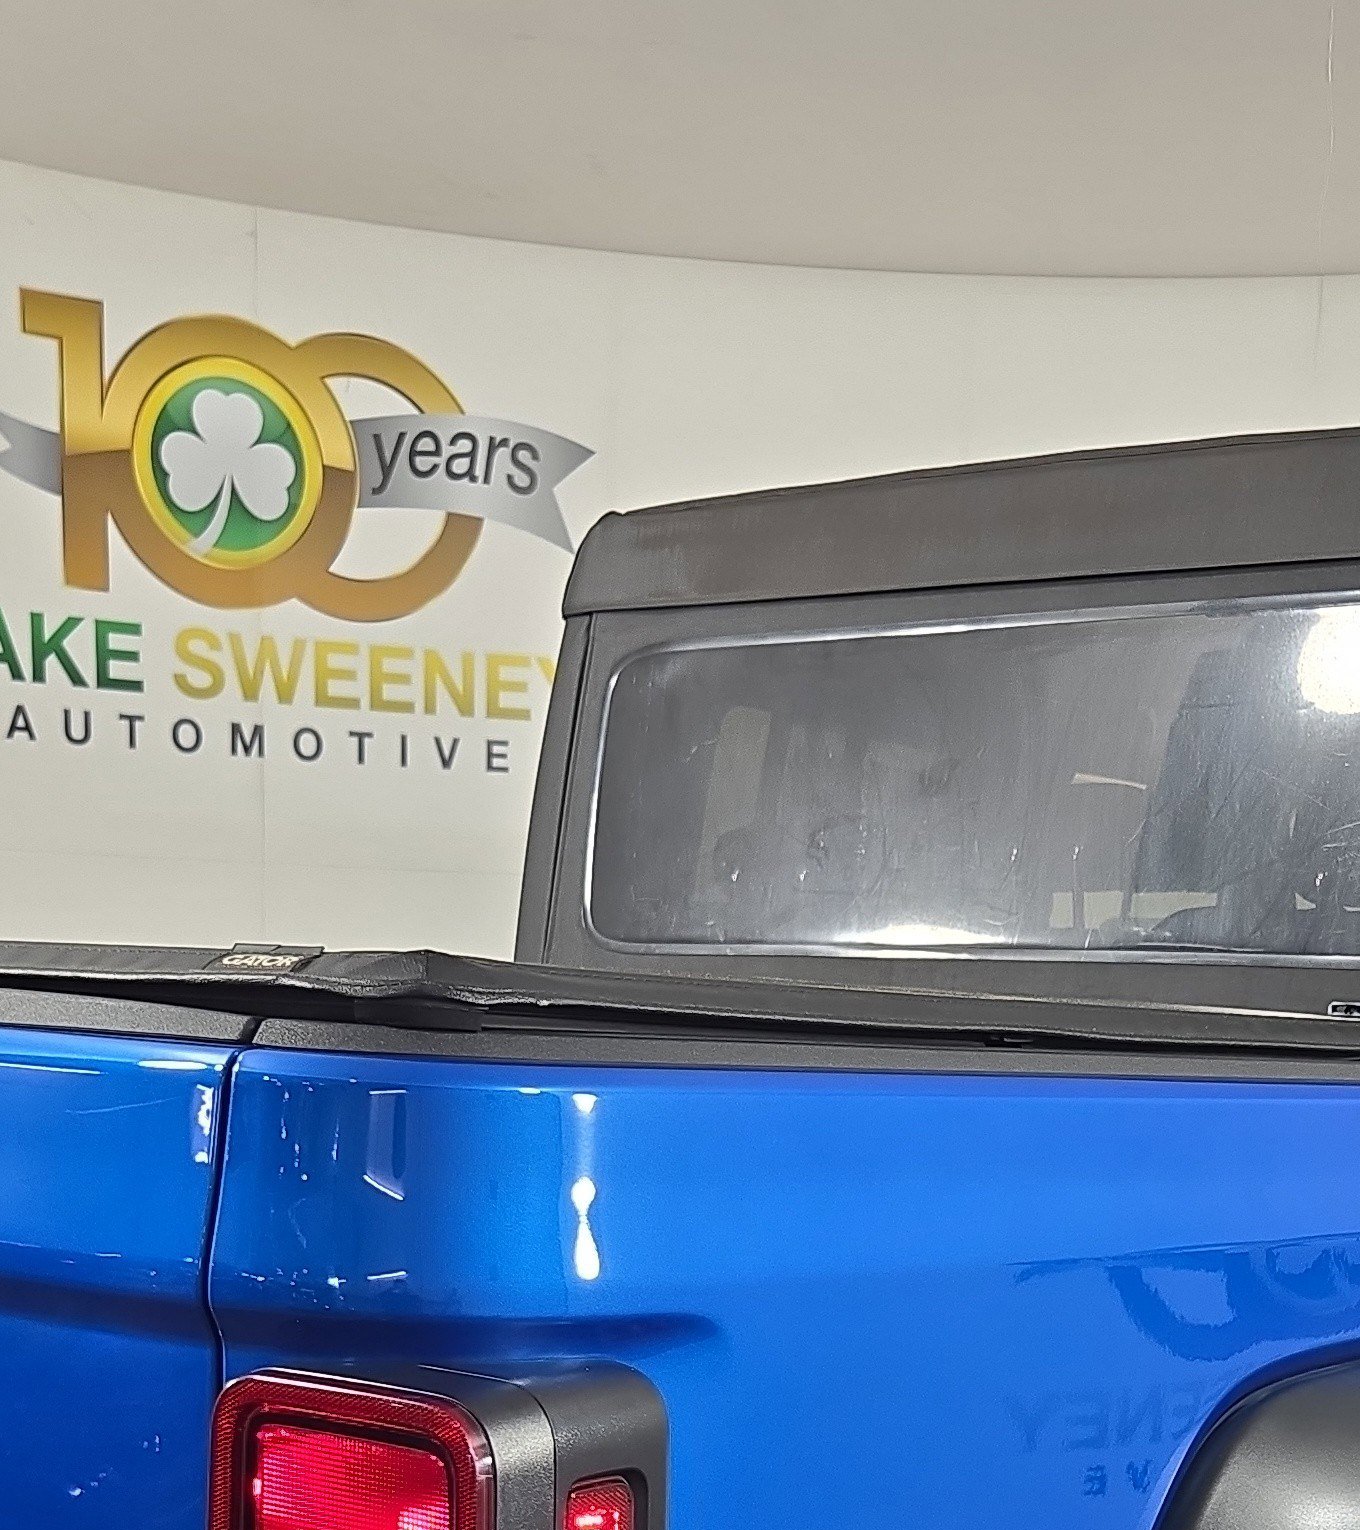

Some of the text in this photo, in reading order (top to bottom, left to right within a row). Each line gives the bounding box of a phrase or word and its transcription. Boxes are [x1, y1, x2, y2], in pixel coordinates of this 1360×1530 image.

[19, 287, 485, 623] 100
[370, 427, 540, 498] years
[6, 704, 510, 774] AUTOMOTIVE
[221, 953, 304, 968] GATOR
